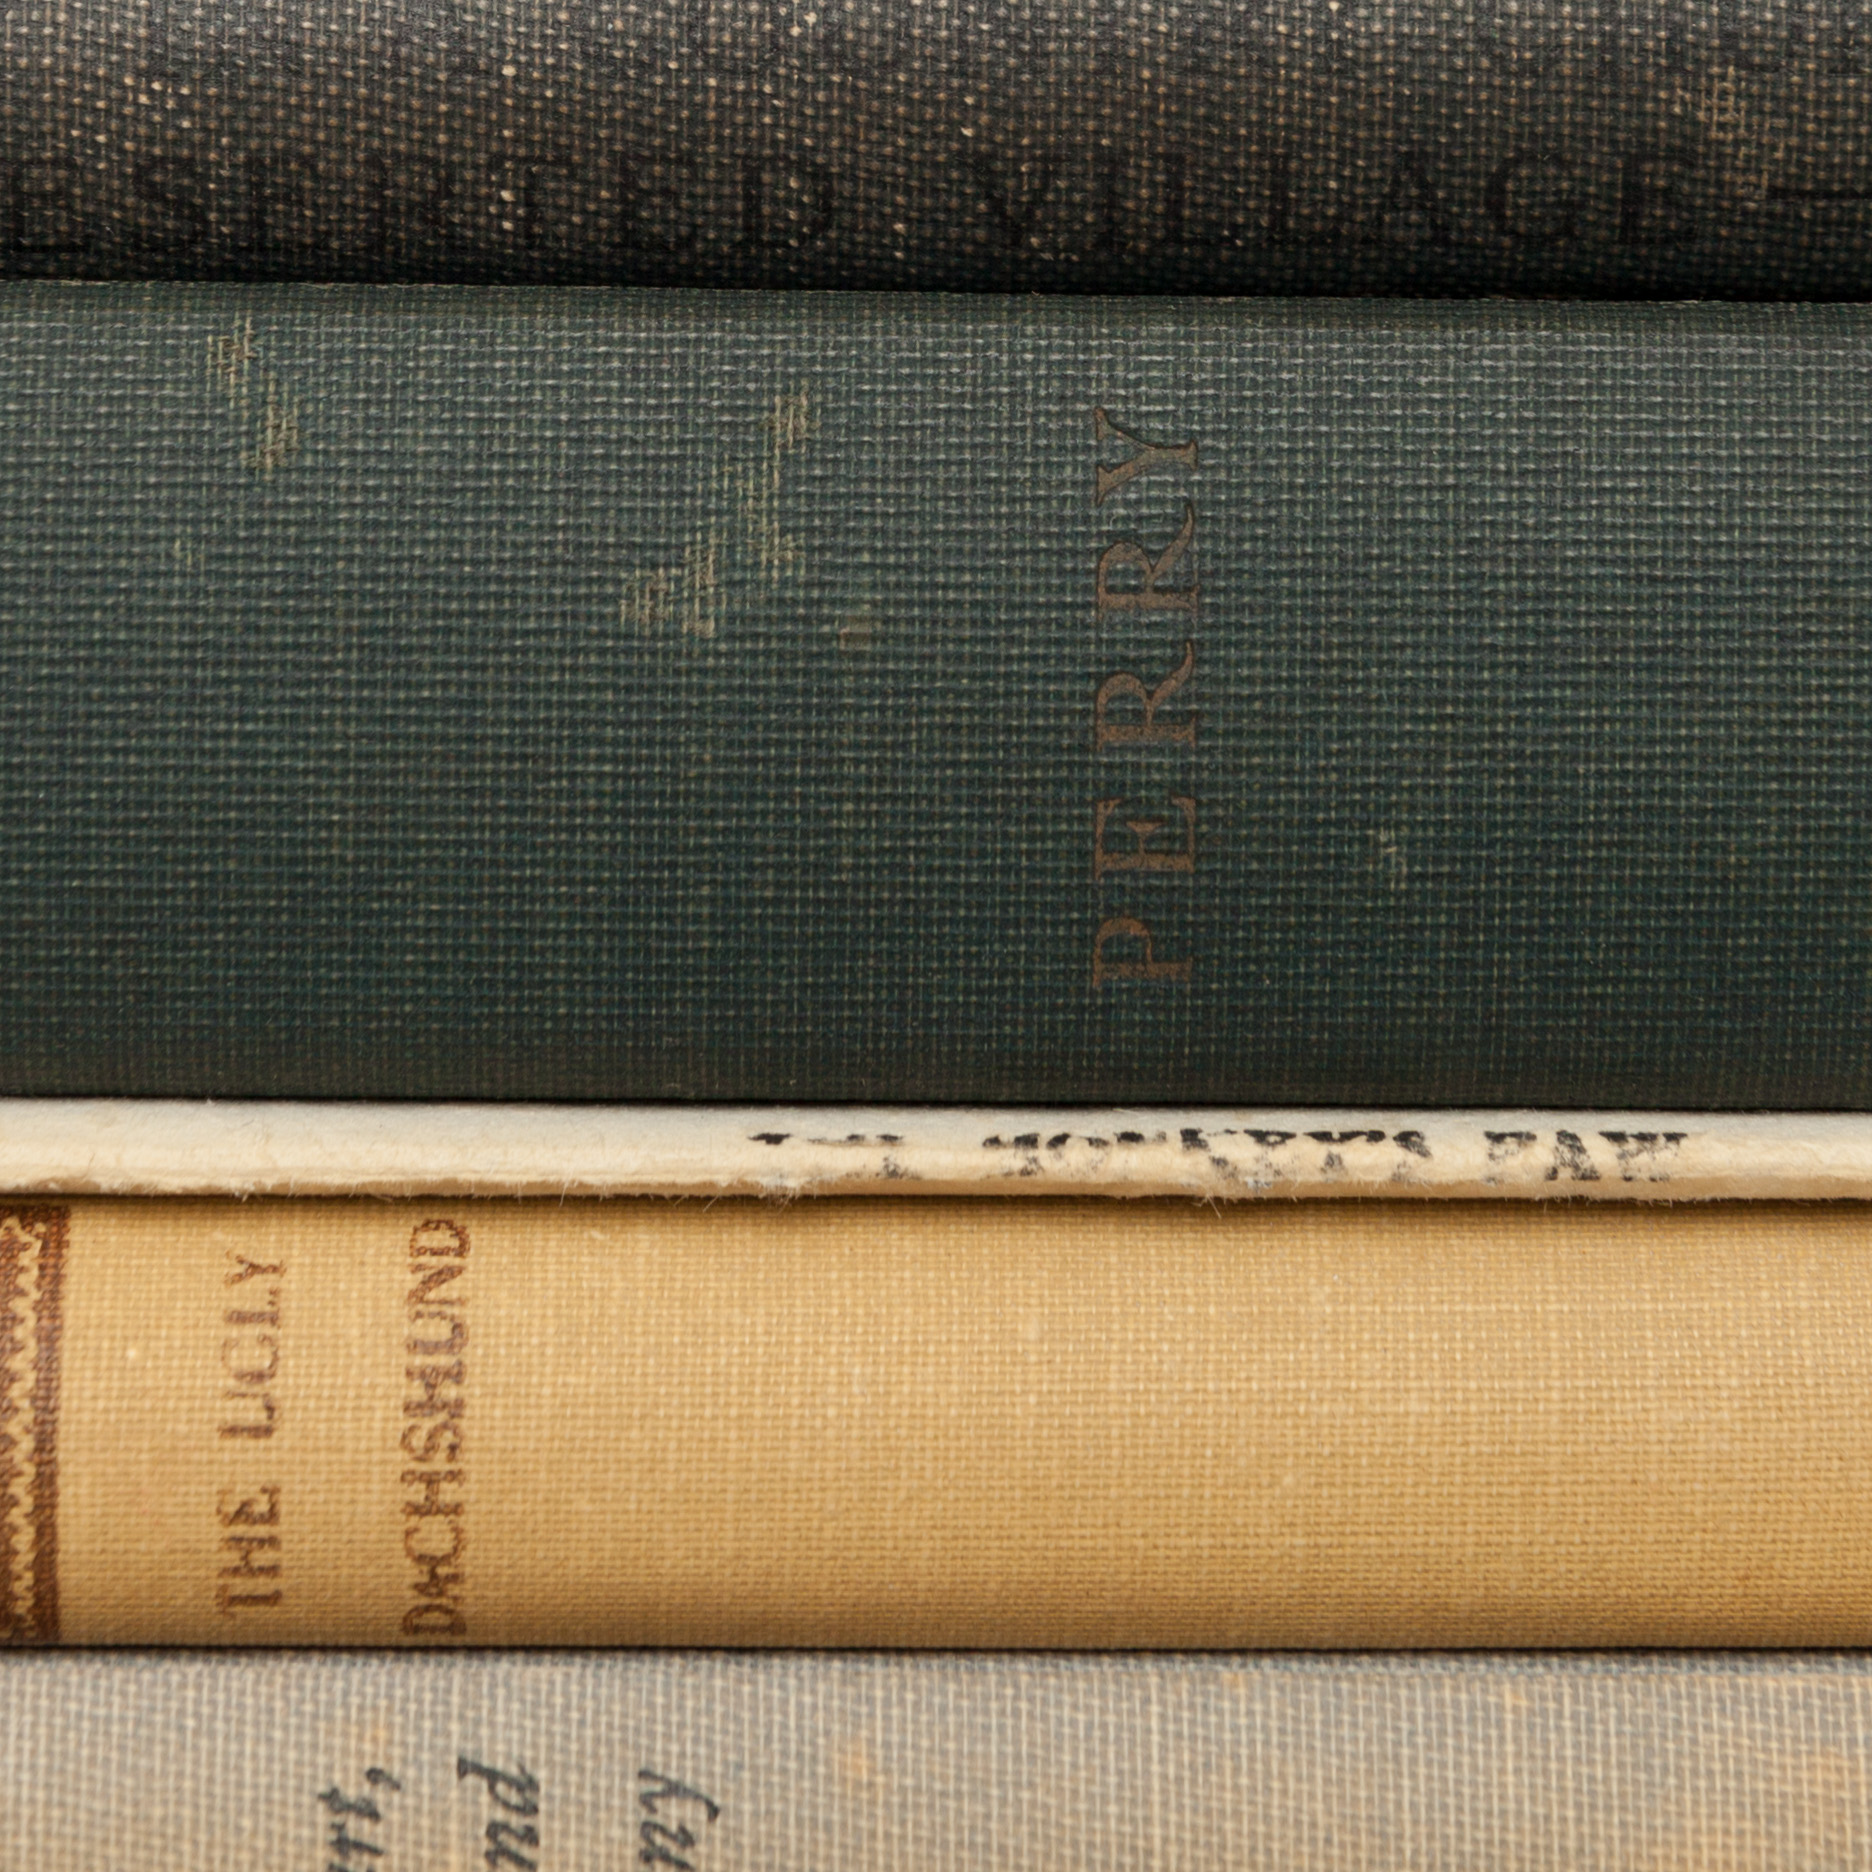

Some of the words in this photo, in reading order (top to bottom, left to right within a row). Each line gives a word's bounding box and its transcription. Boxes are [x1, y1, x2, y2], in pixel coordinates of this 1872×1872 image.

[951, 146, 1702, 252] VILLAGE
[1091, 406, 1202, 990] PERRY
[214, 1246, 288, 1442] UGLY
[398, 1216, 474, 1640] DACHSHUND
[214, 1484, 285, 1620] THE
